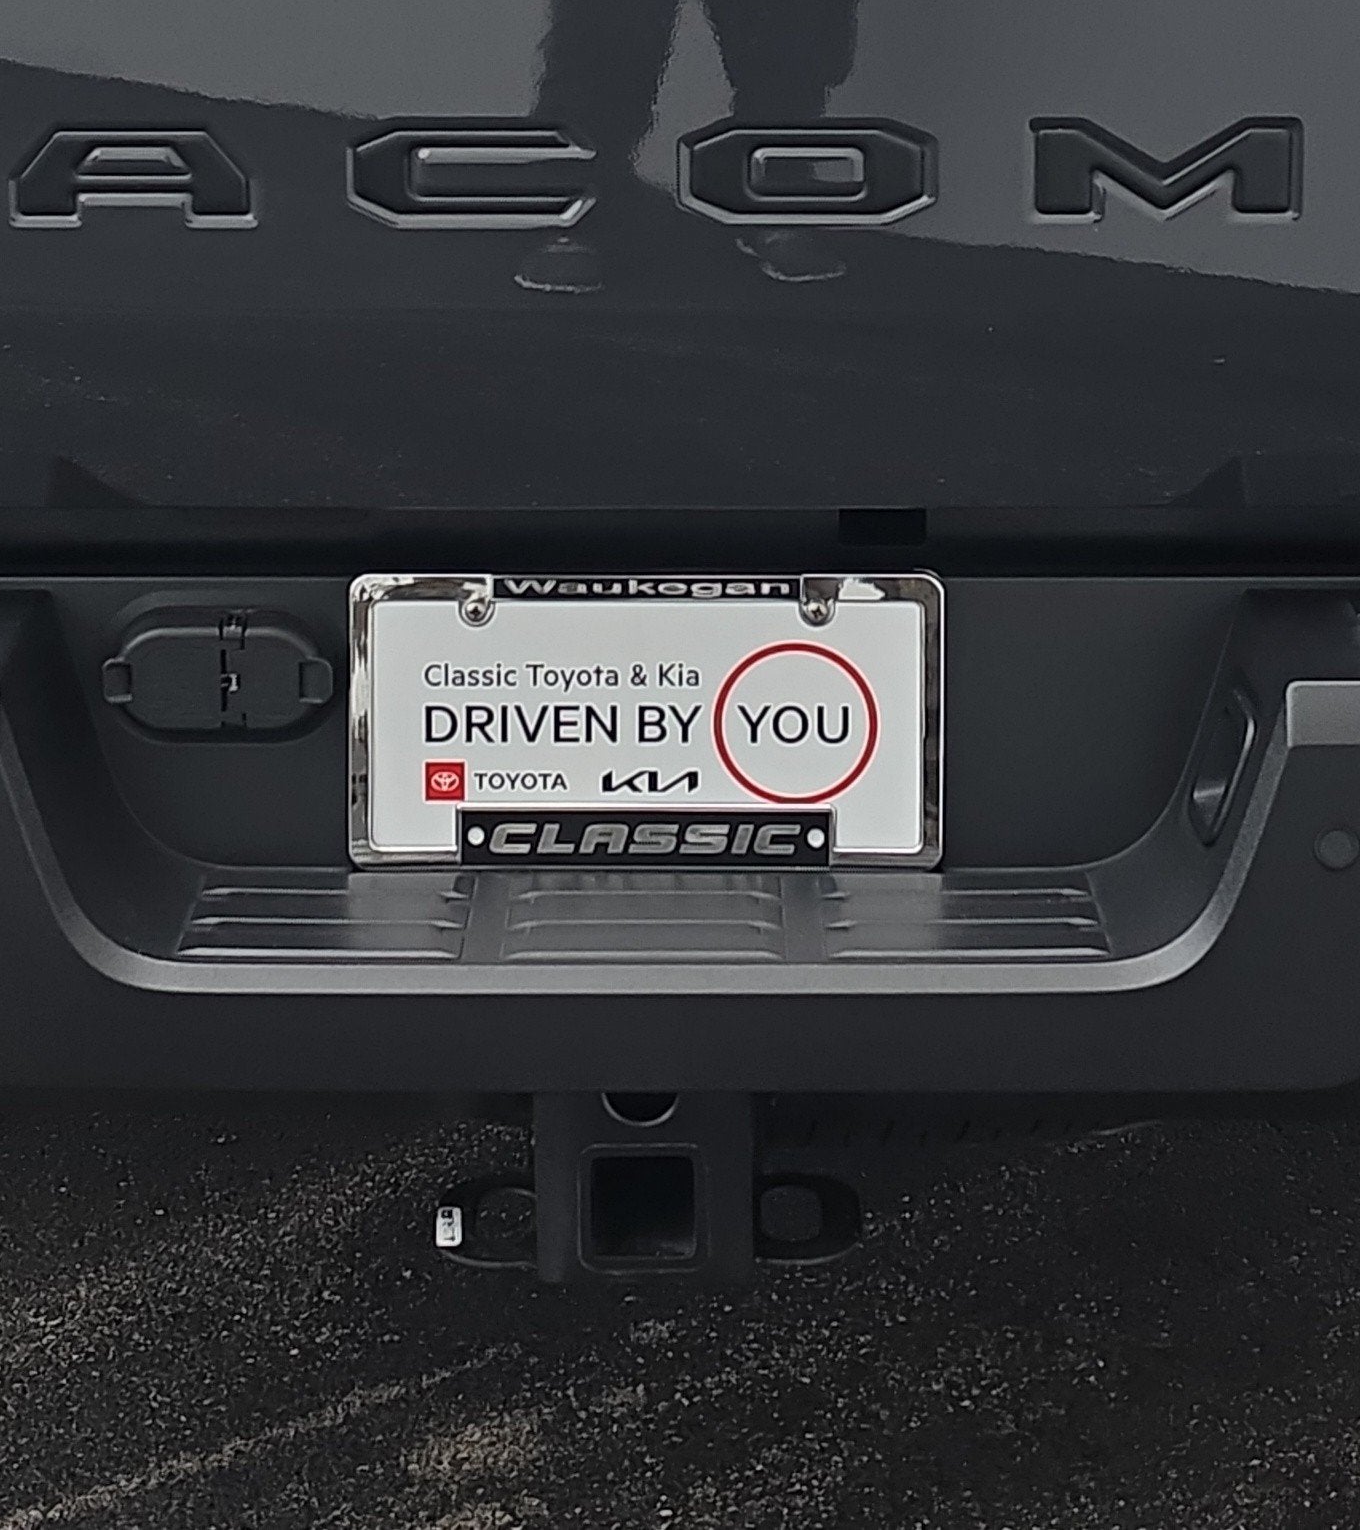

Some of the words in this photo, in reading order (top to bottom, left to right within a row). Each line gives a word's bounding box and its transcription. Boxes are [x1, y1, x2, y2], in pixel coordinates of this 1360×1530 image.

[423, 663, 518, 688] Classic
[525, 663, 619, 694] Toyota
[629, 665, 649, 688] &
[658, 663, 700, 688] Kia
[423, 704, 619, 744] DRIVEN
[638, 704, 702, 744] BY
[739, 704, 851, 744] YOU
[474, 772, 569, 792] TOYOTA
[488, 823, 802, 855] CLASSIC
